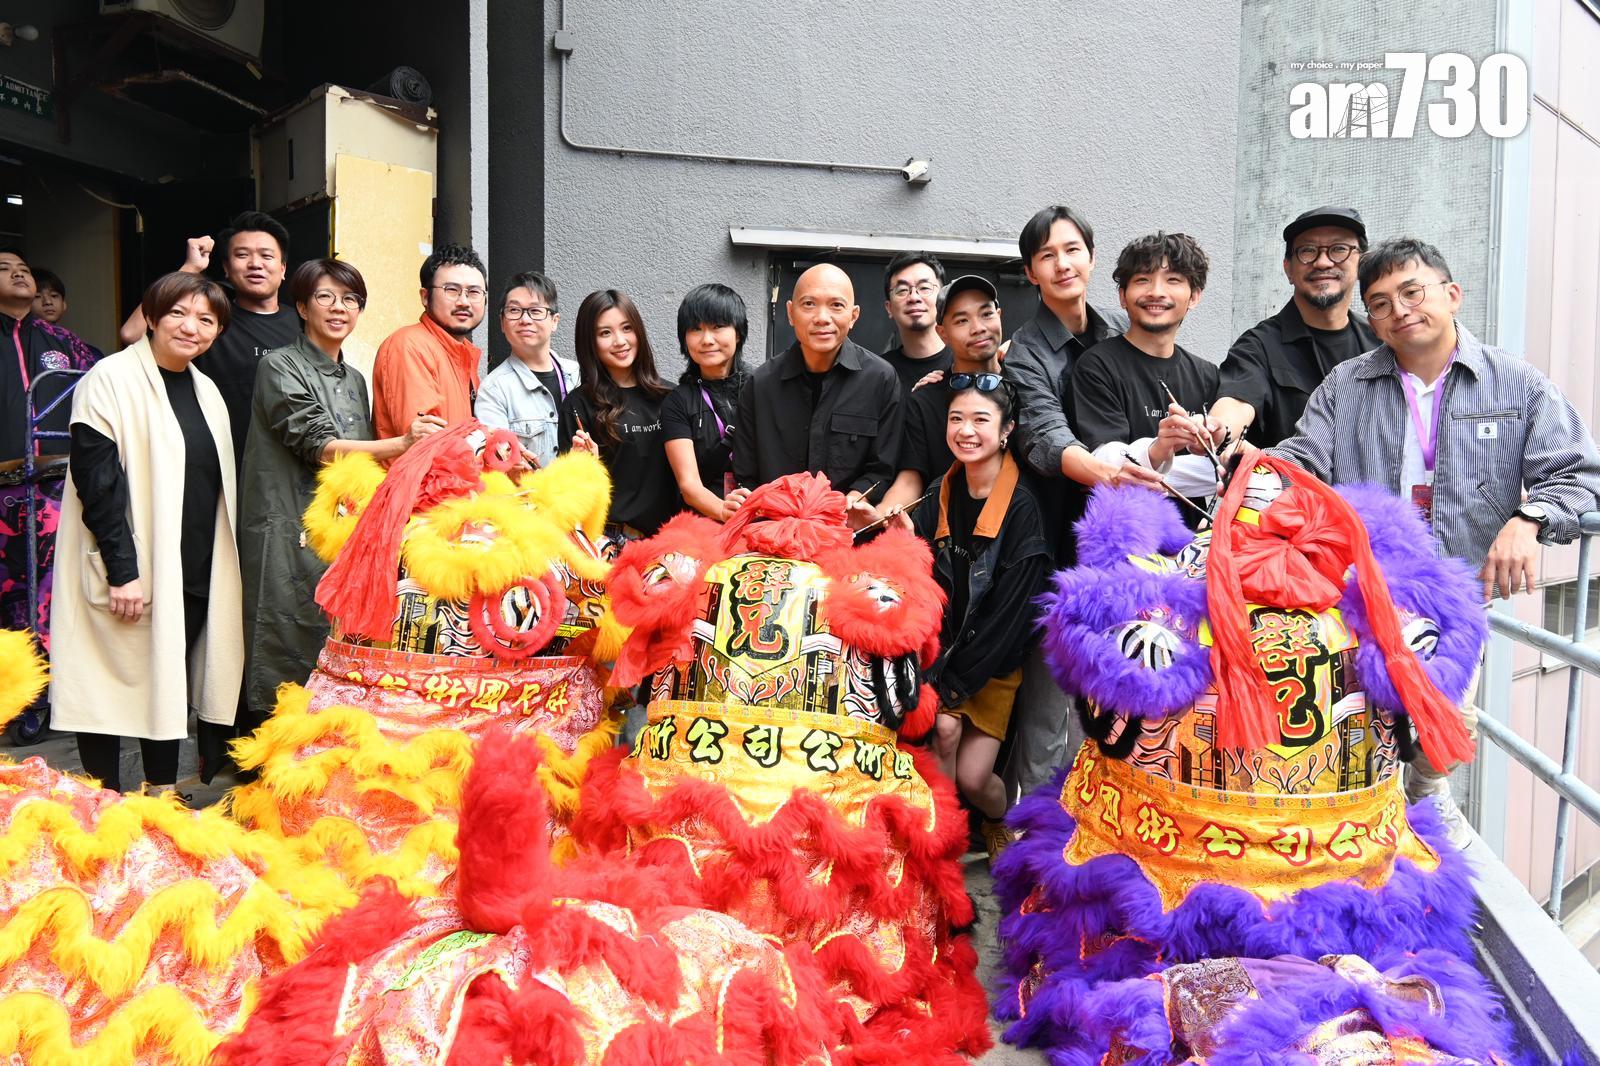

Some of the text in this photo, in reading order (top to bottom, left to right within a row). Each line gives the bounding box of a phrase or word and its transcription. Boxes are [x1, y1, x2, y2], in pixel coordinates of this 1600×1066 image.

[1151, 408, 1163, 418] am
[631, 424, 642, 433] am
[642, 419, 662, 433] work
